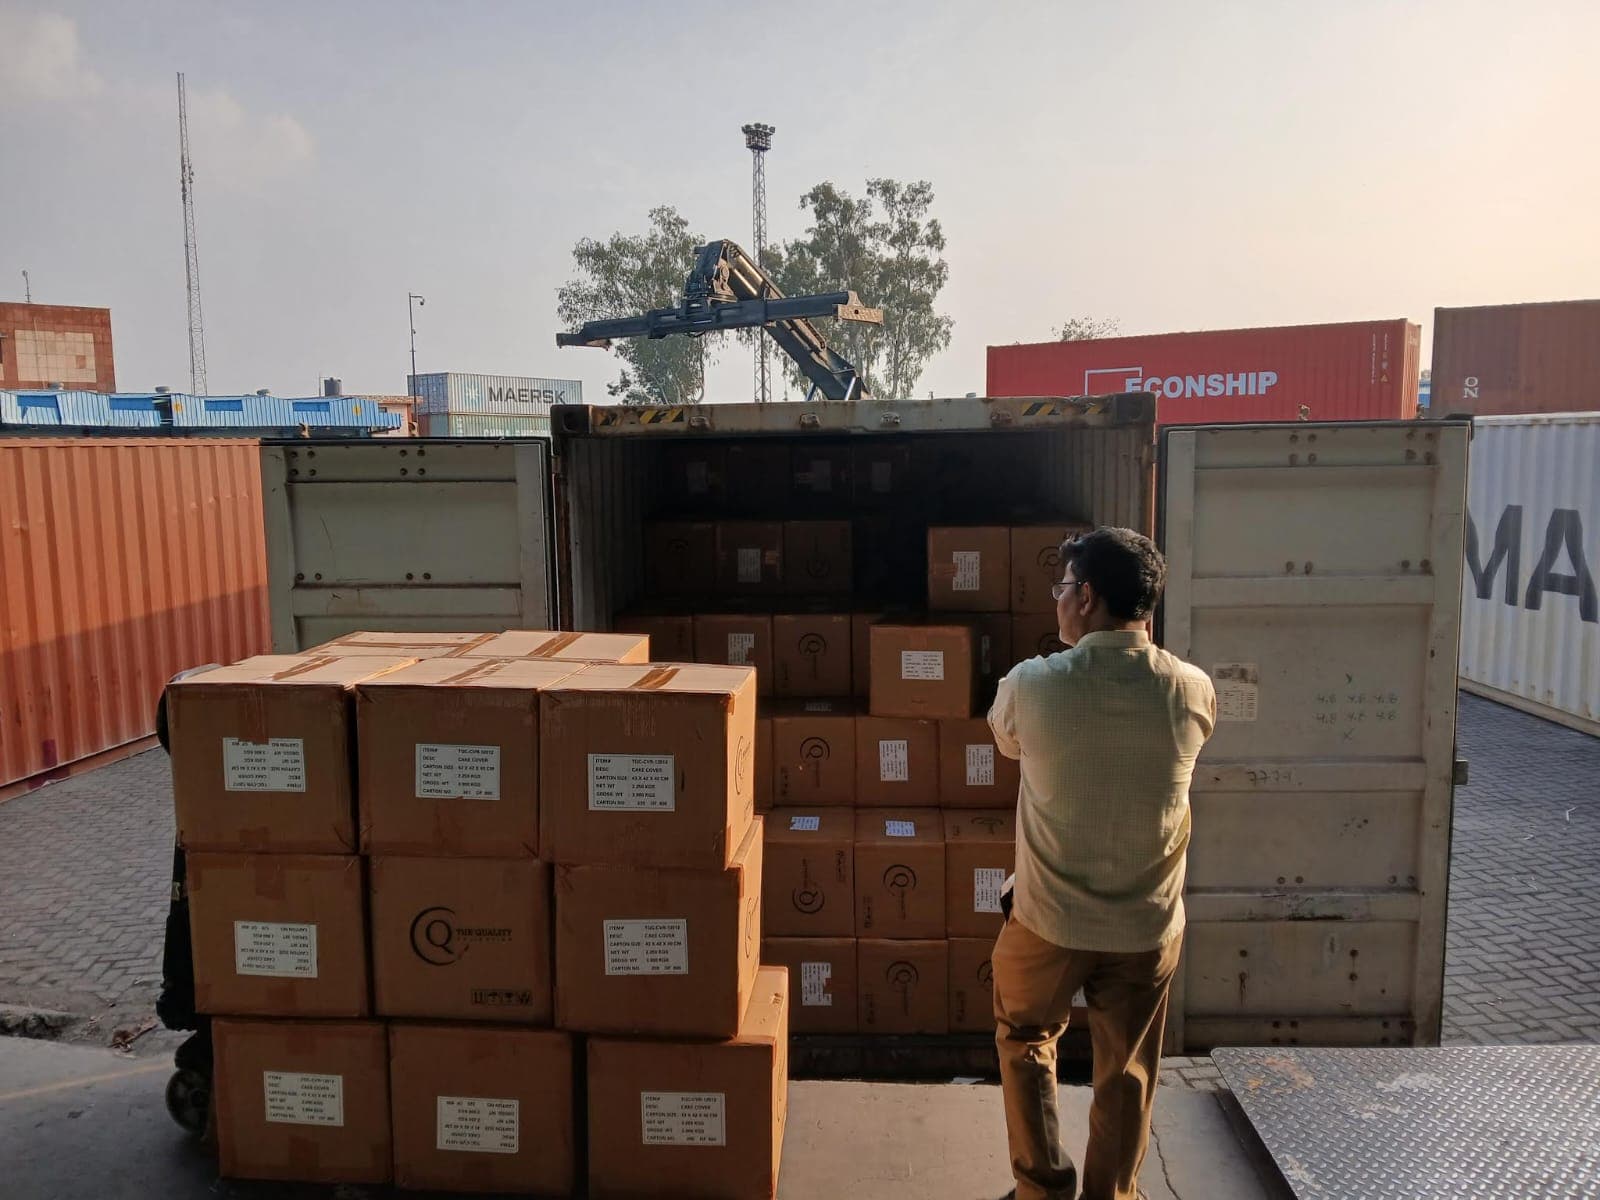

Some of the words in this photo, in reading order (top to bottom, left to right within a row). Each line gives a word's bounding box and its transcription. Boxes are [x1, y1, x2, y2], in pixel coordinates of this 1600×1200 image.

[1125, 371, 1277, 398] ECONSHIP
[489, 386, 566, 405] MAERSK
[475, 928, 512, 937] QUALITY
